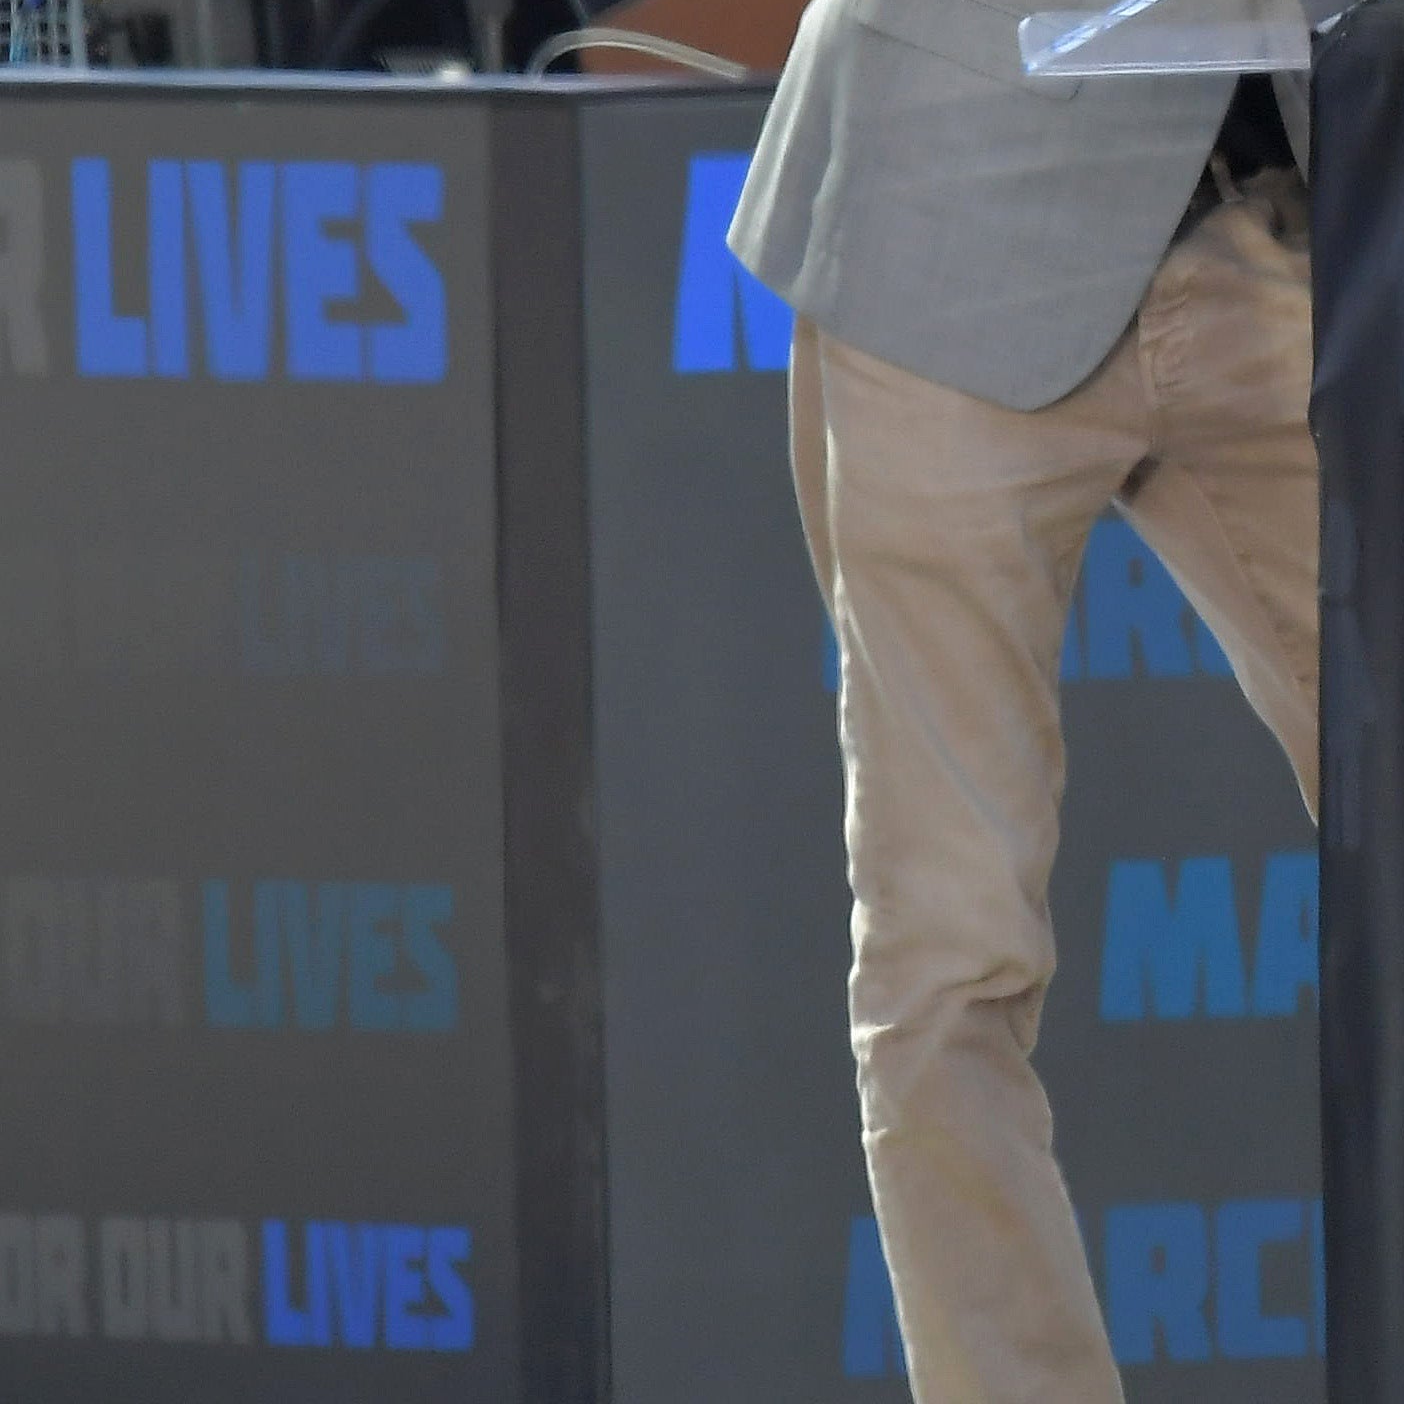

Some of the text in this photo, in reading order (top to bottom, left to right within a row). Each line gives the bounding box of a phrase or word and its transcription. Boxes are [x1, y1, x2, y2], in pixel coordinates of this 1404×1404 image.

[71, 156, 449, 384] LIVES
[202, 877, 460, 1033] LIVES
[101, 1215, 254, 1348] OUR
[261, 1217, 477, 1354] LIVES
